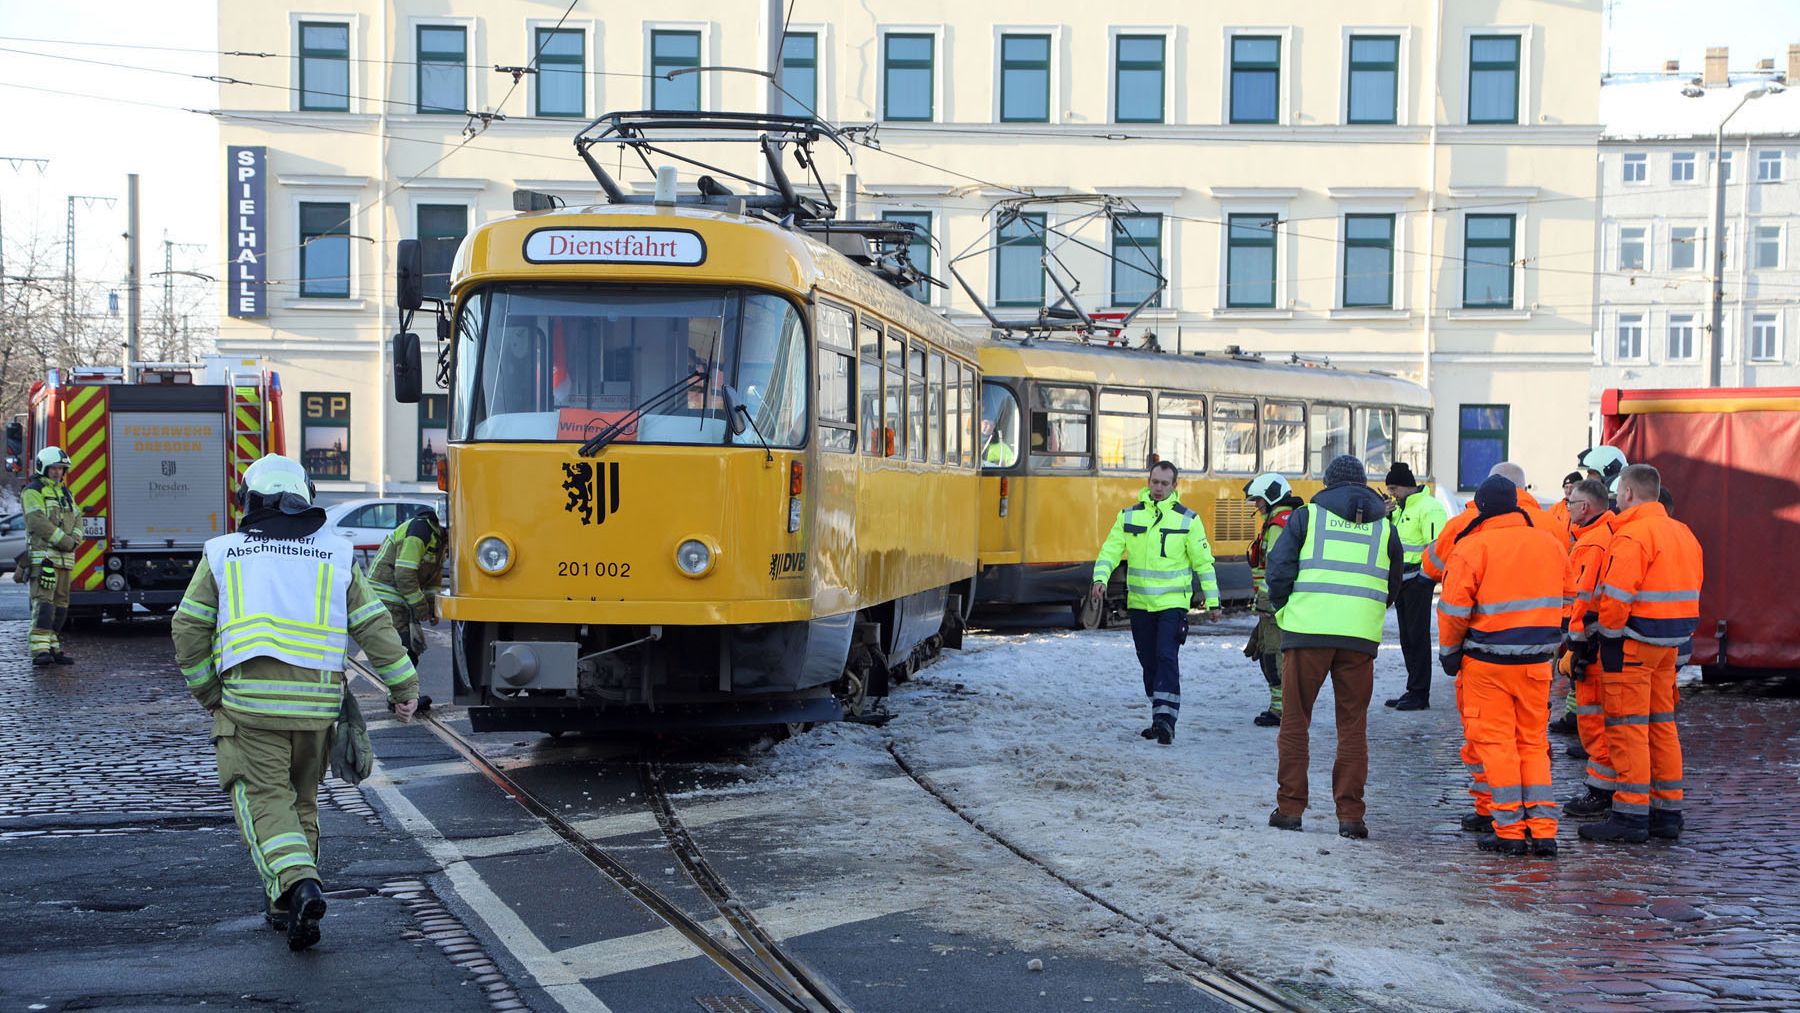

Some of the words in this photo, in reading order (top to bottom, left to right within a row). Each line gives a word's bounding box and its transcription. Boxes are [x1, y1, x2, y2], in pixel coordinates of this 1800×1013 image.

[237, 151, 258, 313] SPIELHALLE
[548, 234, 678, 258] Dienstfahrt
[124, 425, 213, 437] FEUERWEHR
[134, 440, 203, 452] DRESDEN
[208, 511, 218, 533] 1
[1330, 519, 1352, 529] DVB
[1353, 521, 1369, 531] AG
[226, 543, 334, 560] Abschnittsleiter
[782, 552, 806, 572] DVB
